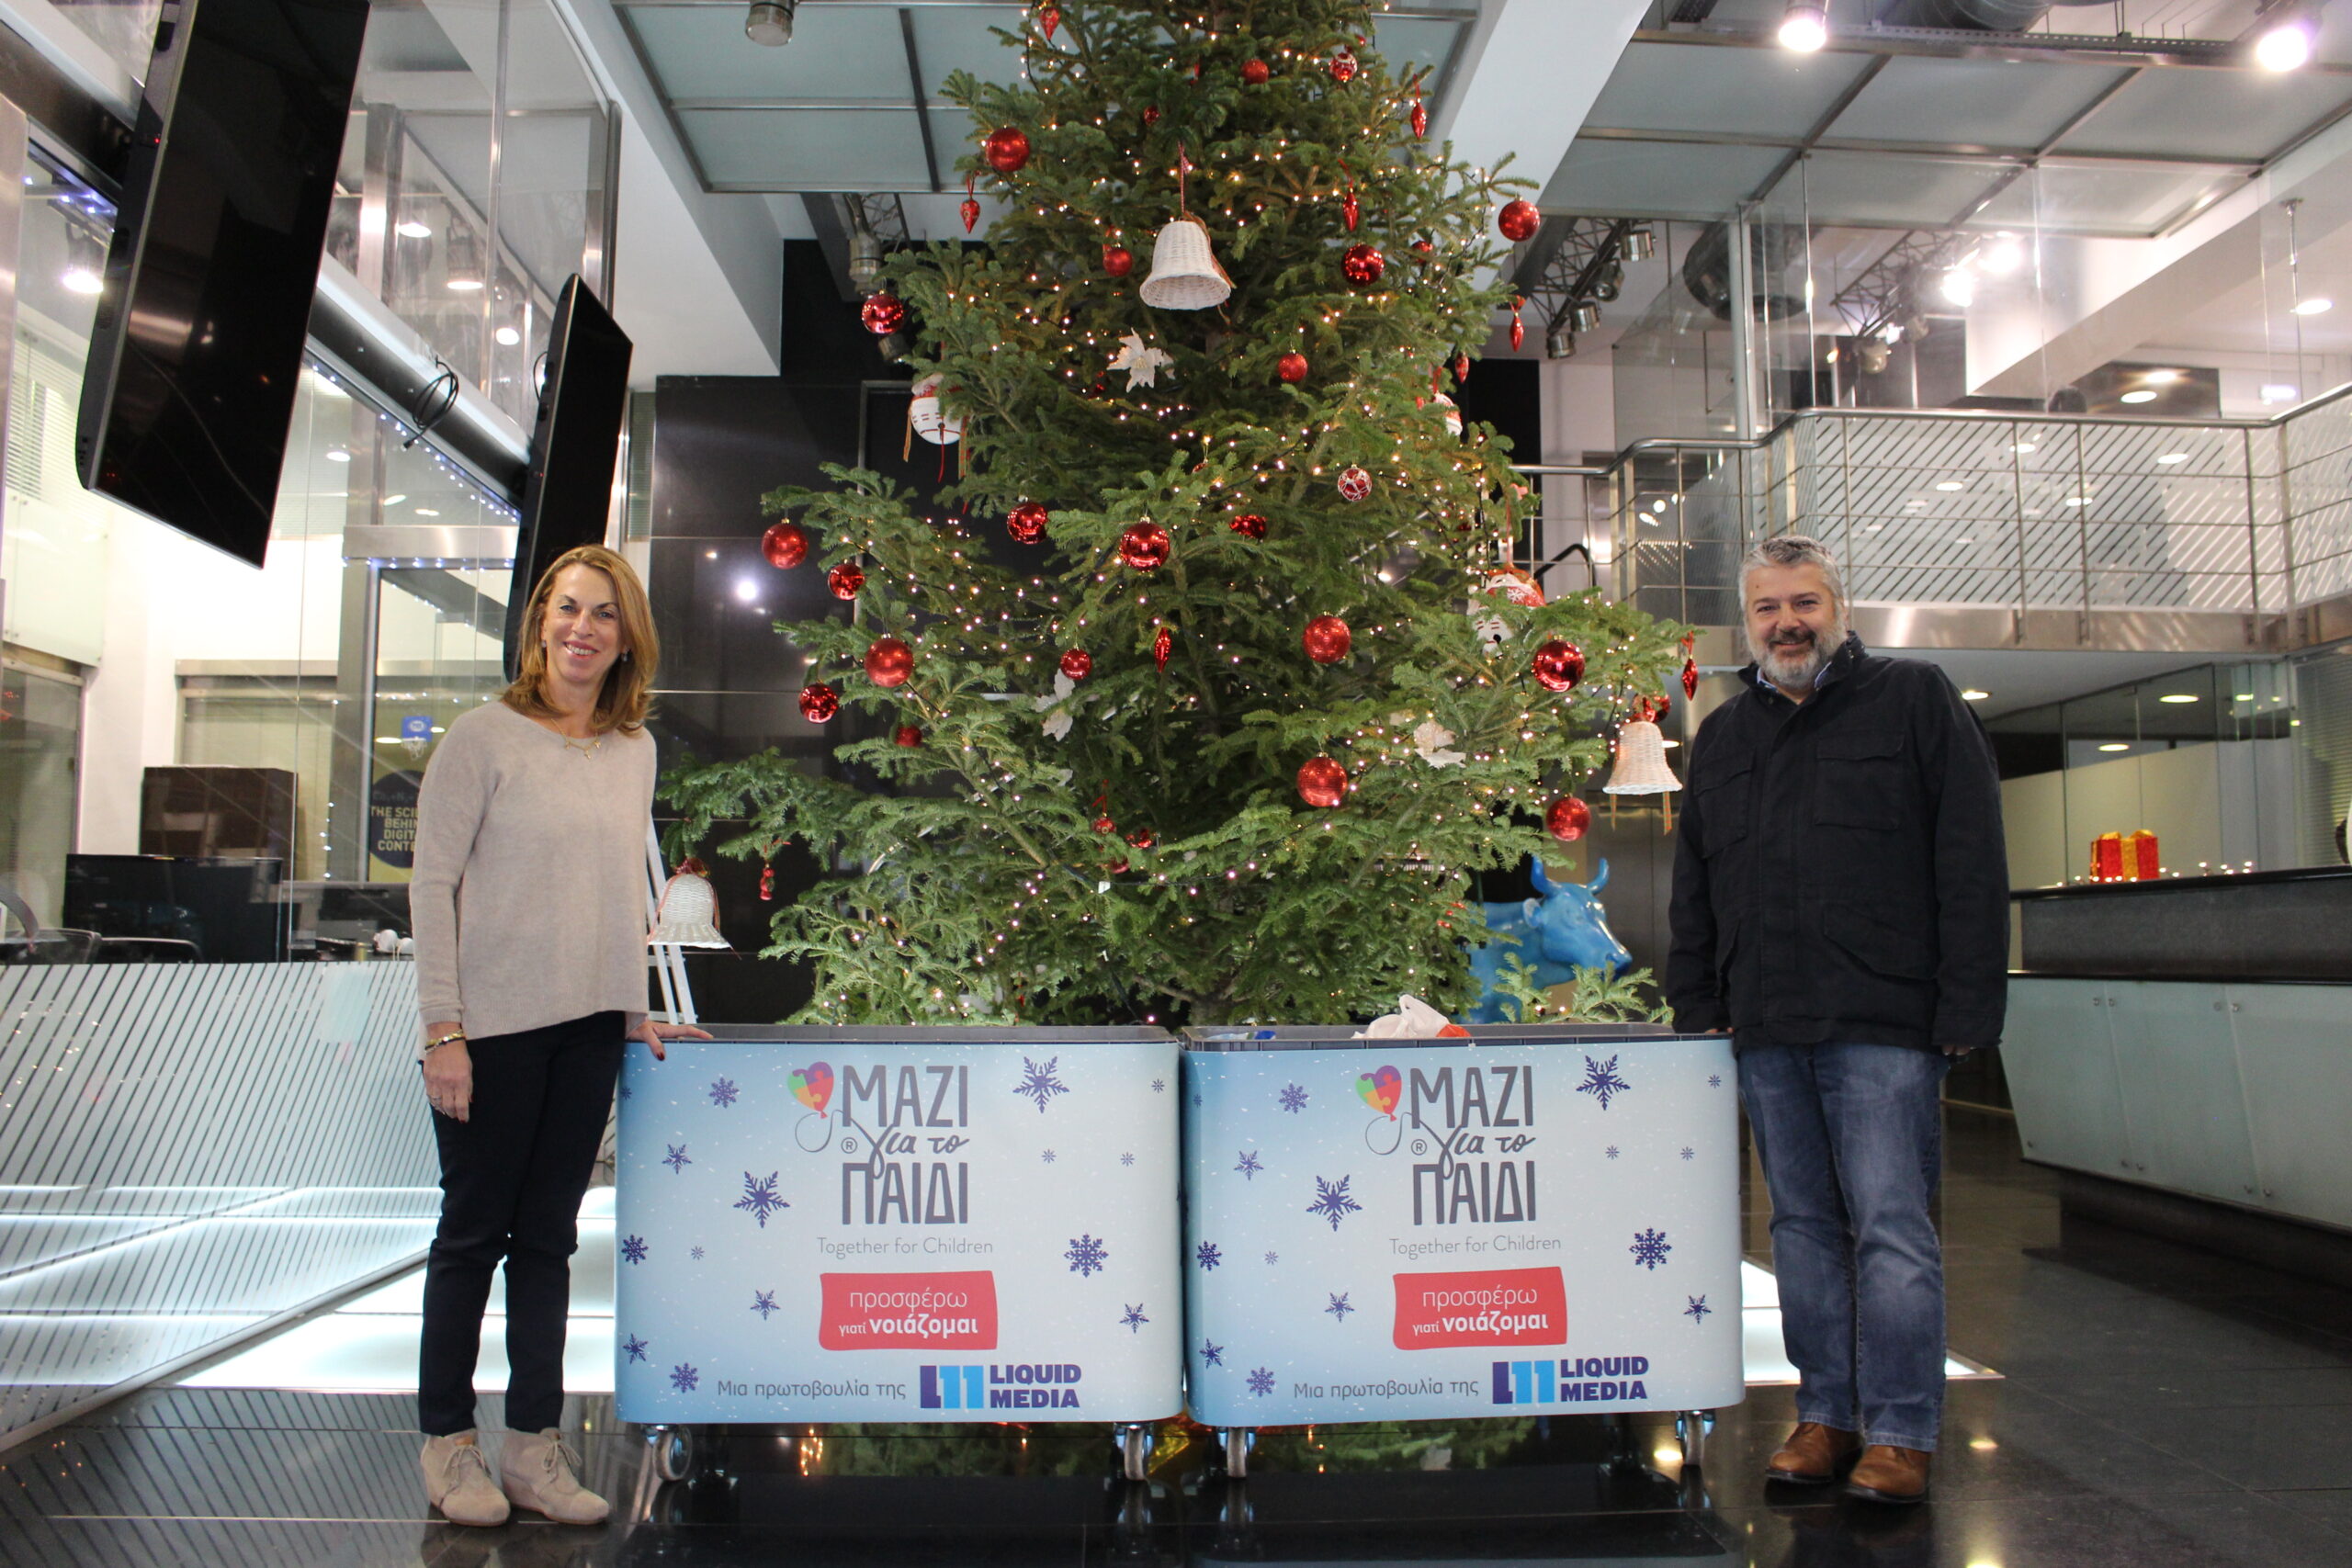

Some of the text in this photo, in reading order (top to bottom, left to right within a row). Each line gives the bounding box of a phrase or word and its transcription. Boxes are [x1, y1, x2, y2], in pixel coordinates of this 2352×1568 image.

[370, 807, 393, 818] THE
[927, 1135, 969, 1154] το
[1495, 1134, 1536, 1154] το
[842, 1162, 967, 1224] ΠΑΙΔΙ
[1413, 1160, 1536, 1225] ΠΑΙΔΙ
[817, 1236, 993, 1259] Together for Children
[1389, 1235, 1562, 1260] Together for Children
[850, 1287, 967, 1313] προσφέρω
[1422, 1284, 1537, 1312] προσφέρω
[838, 1314, 978, 1338] γιατί νοιάζομαι
[1412, 1311, 1549, 1337] γιατί νοιάζομαι
[989, 1364, 1081, 1385] LIQUID
[1560, 1356, 1649, 1378] LIQUID
[718, 1379, 906, 1400] Μια πρωτοβουλία της
[990, 1389, 1080, 1408] MEDIA
[1295, 1377, 1479, 1401] Μια πρωτοβουλία της
[1561, 1381, 1647, 1402] MEDIA
